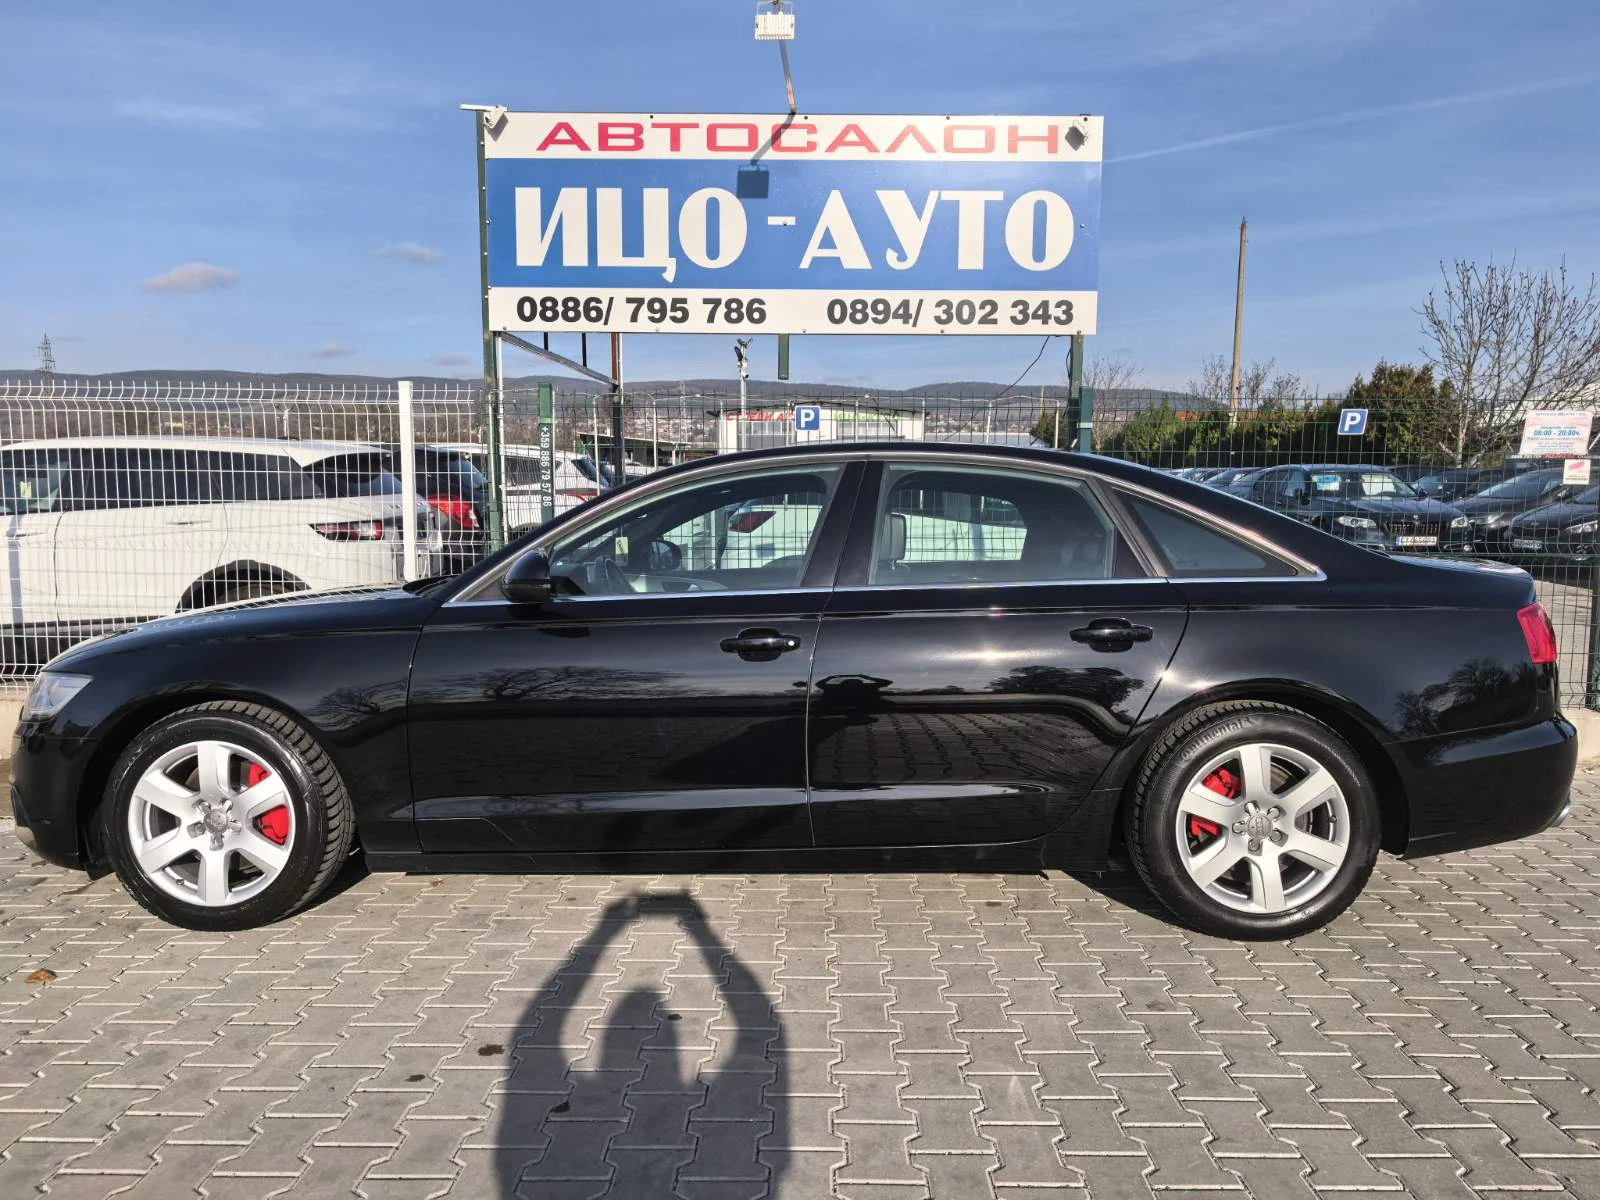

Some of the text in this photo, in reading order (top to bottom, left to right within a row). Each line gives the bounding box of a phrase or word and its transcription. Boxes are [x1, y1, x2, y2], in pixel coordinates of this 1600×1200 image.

[536, 122, 1058, 154] АВТОСАЛОН
[516, 296, 767, 325] 0886/ 795 786
[826, 298, 1074, 327] 0894/ 302 343
[800, 409, 815, 428] P
[1343, 412, 1361, 432] P
[541, 425, 552, 507] +359 886 79 57 86
